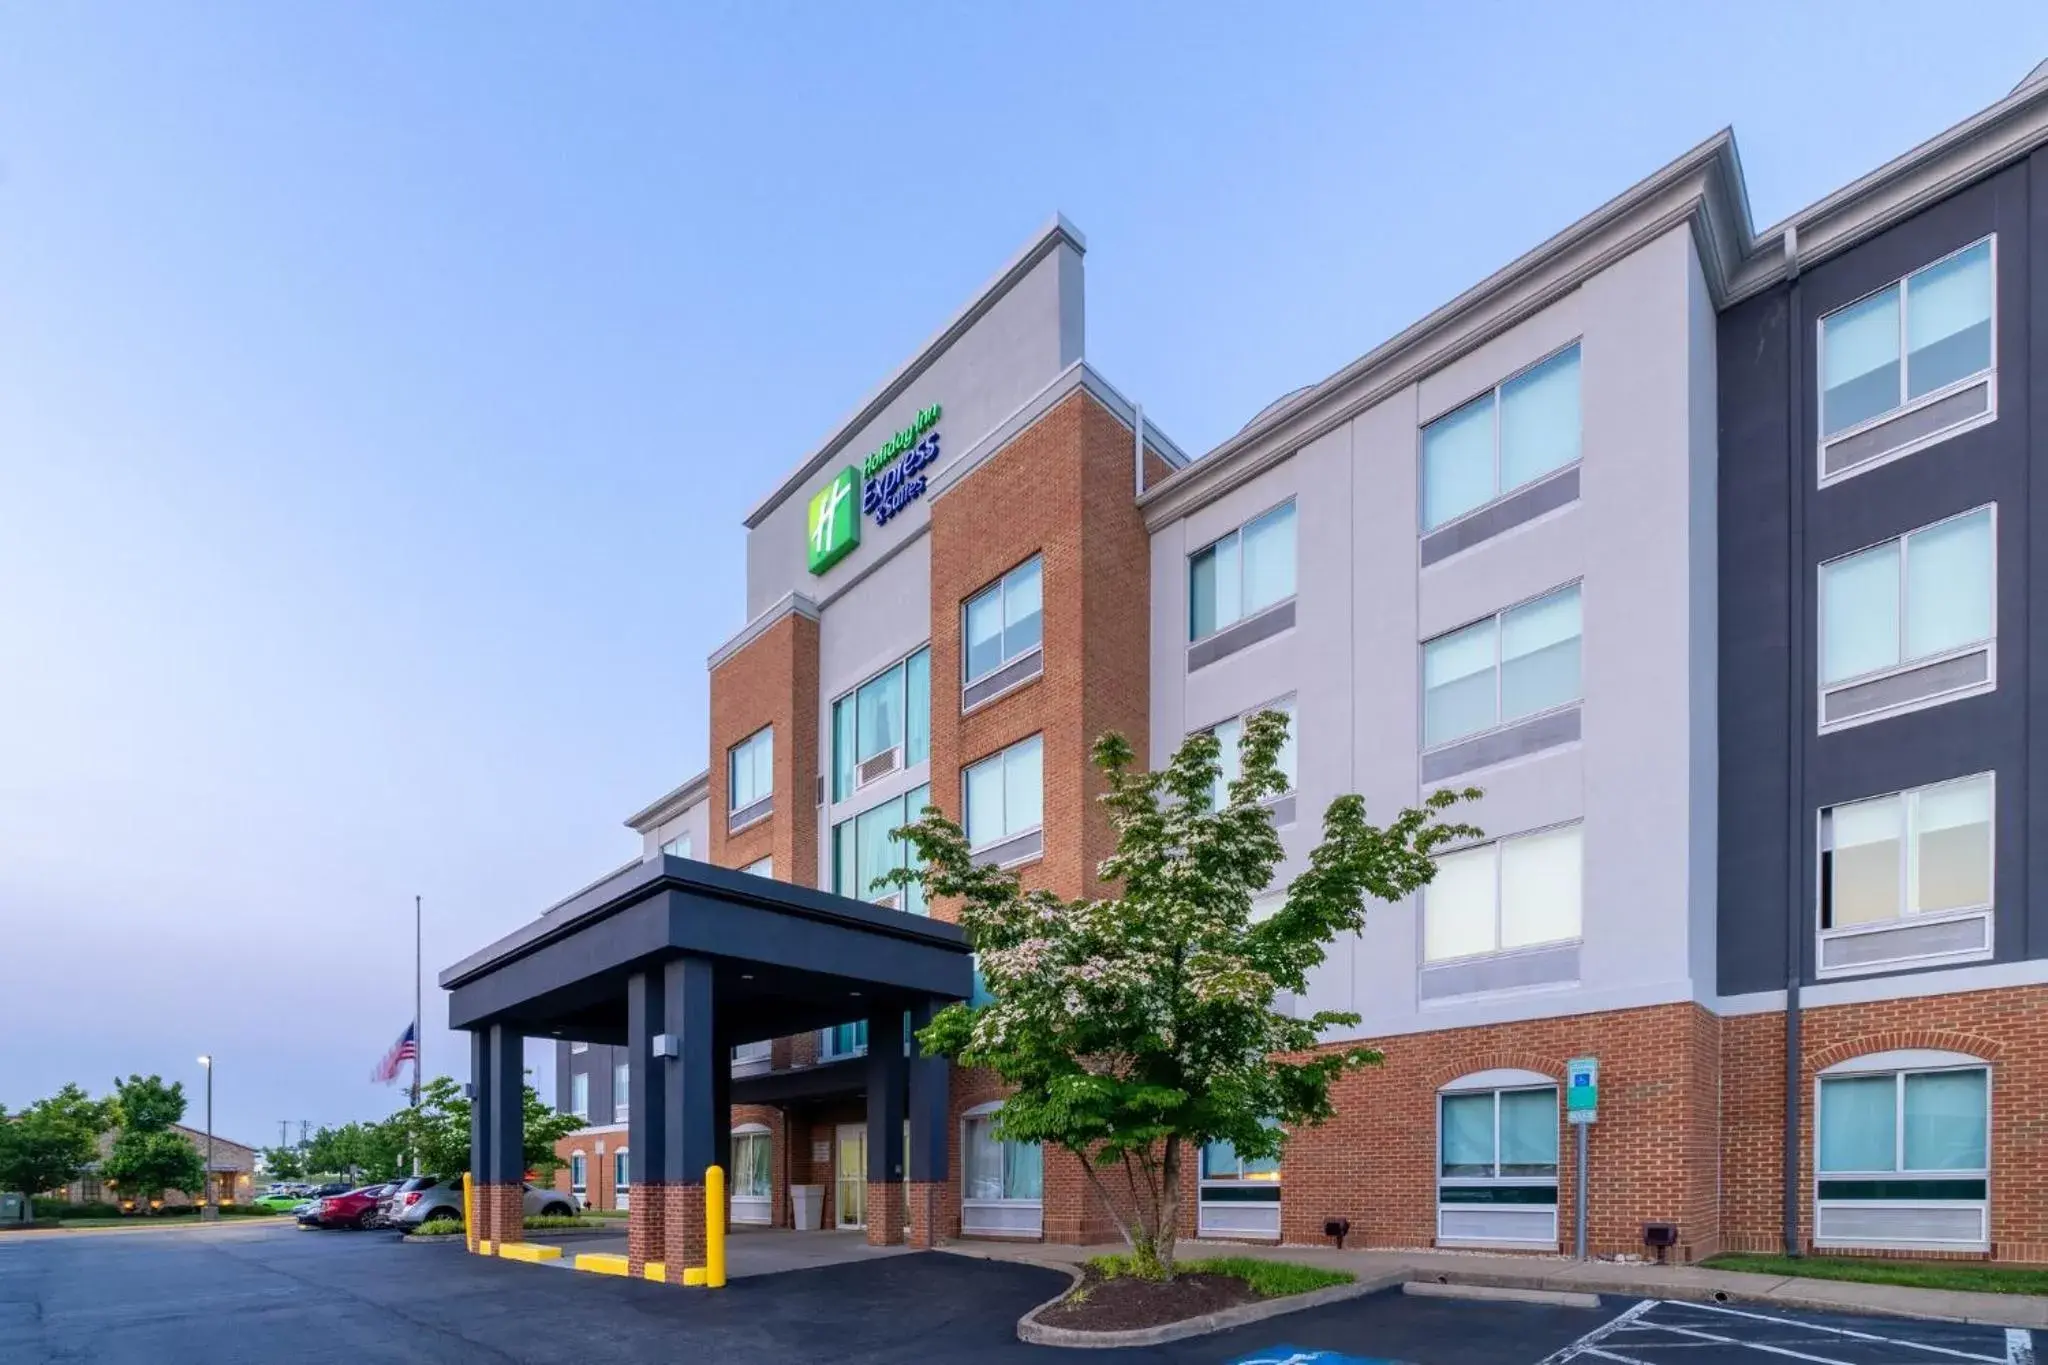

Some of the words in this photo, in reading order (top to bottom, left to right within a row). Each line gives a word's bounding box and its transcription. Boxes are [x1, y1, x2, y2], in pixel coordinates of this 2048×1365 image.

[862, 425, 917, 480] Holiday
[914, 403, 942, 434] Inn
[863, 431, 941, 515] Express
[885, 474, 928, 519] Suites
